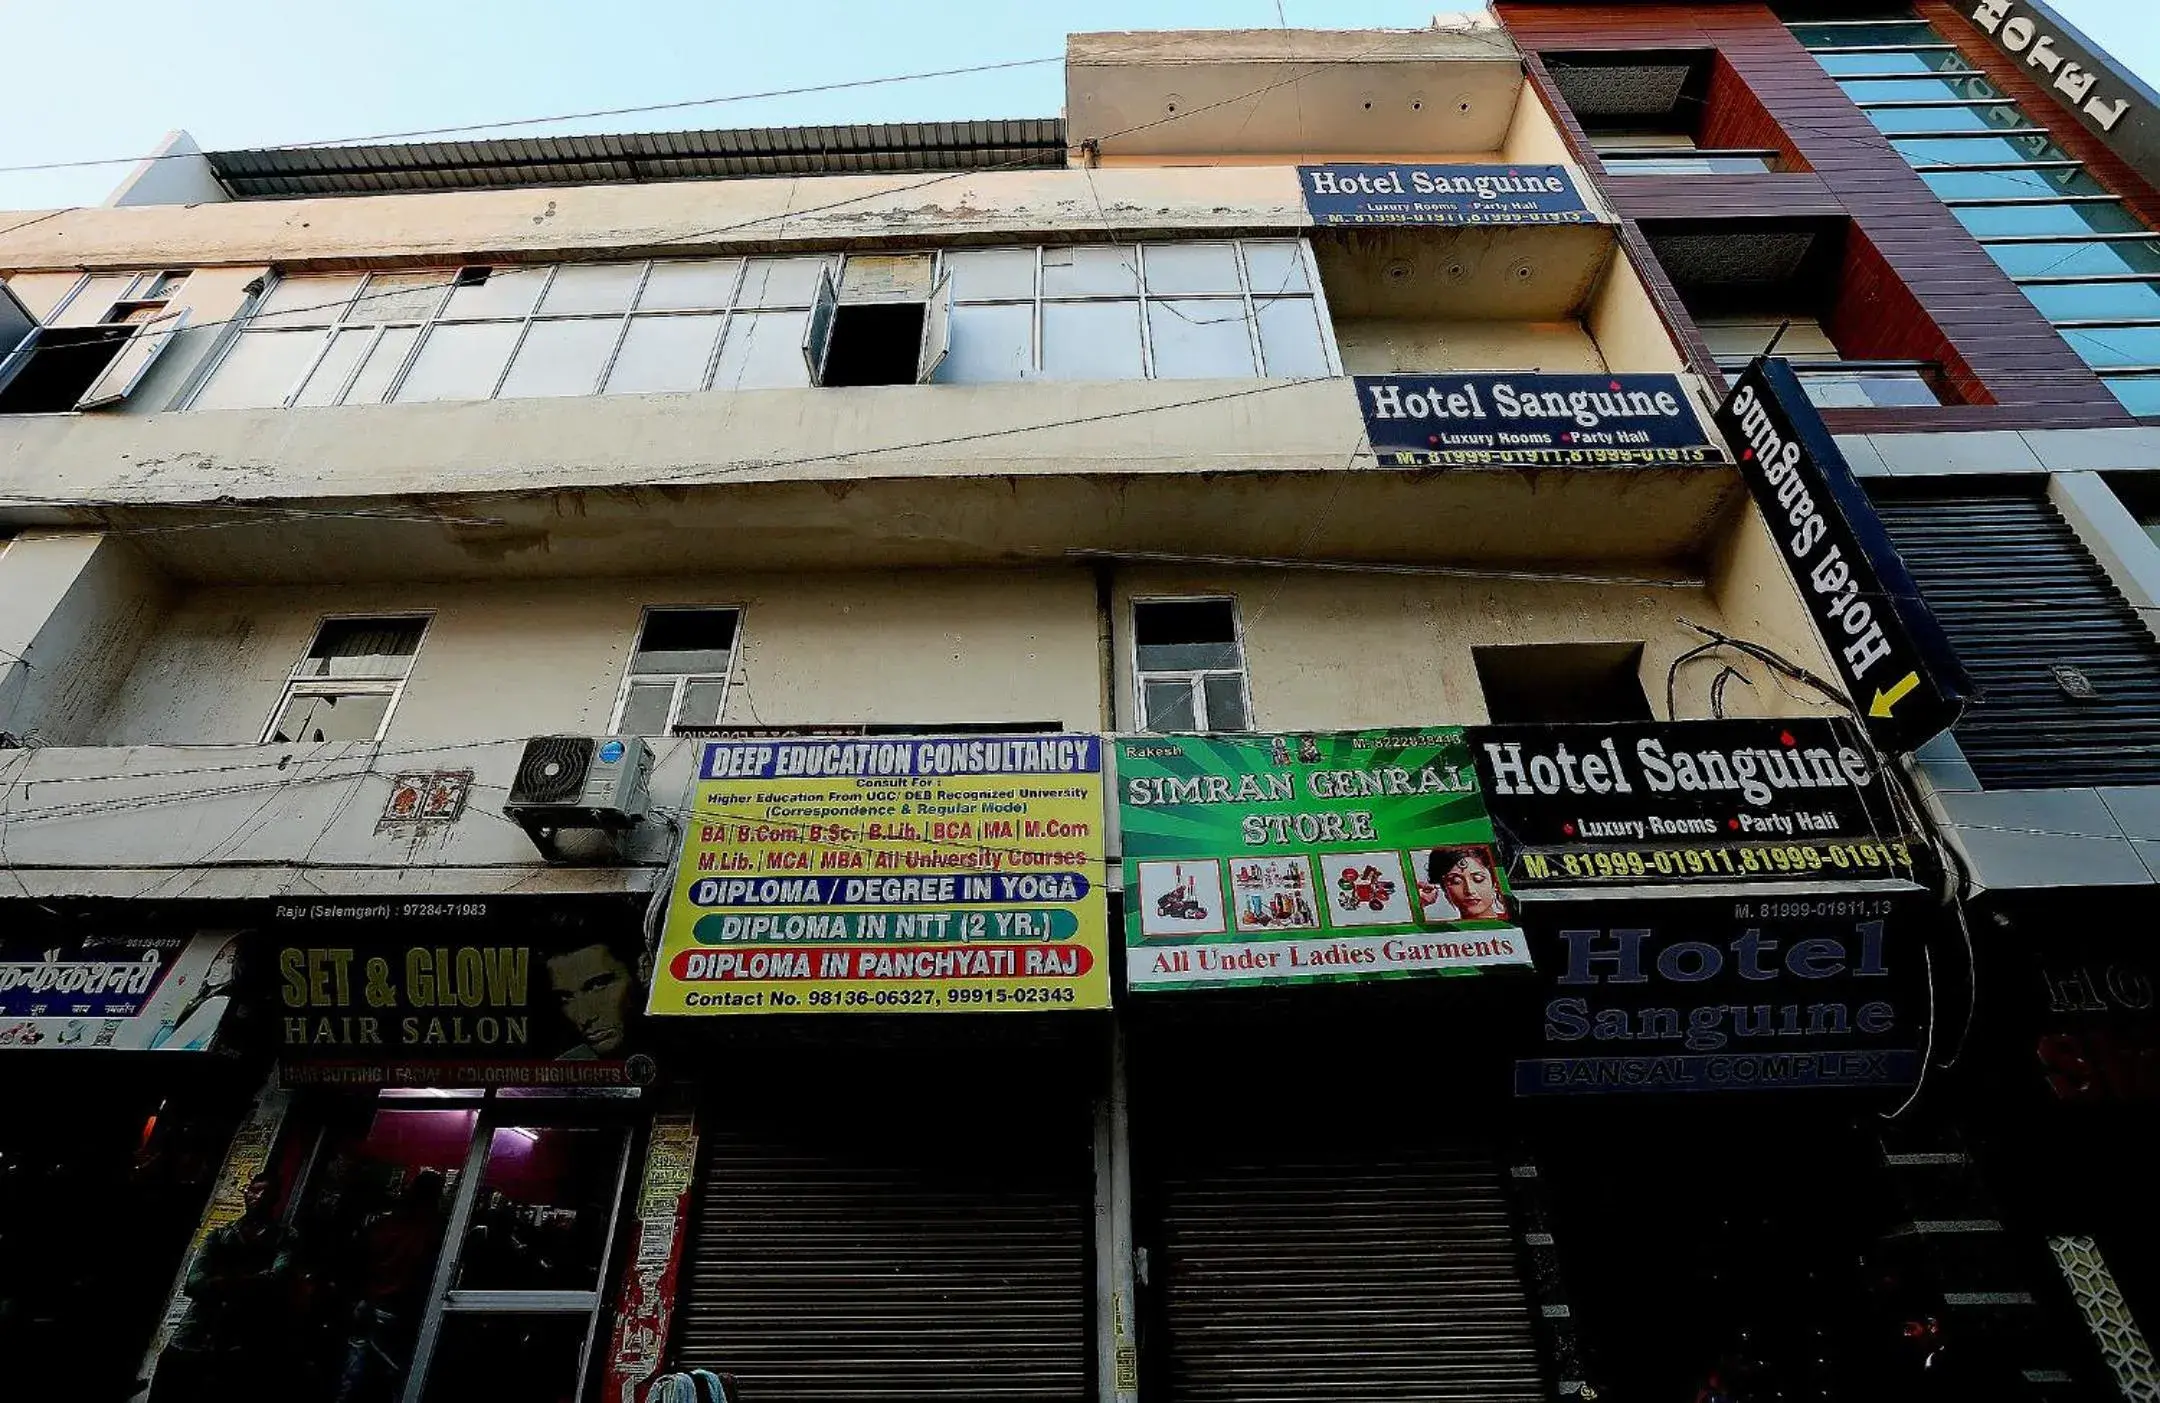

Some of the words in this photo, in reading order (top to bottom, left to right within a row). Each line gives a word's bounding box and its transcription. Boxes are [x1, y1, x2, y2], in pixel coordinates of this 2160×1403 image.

[1973, 0, 2131, 132] HOTEL
[1310, 171, 1405, 194] Hotel
[1411, 169, 1565, 200] Sanguine
[1367, 202, 1409, 212] Luxury
[1414, 202, 1458, 211] Rooms
[1472, 202, 1507, 212] Party
[1511, 202, 1539, 210] Hall
[1369, 383, 1487, 419] Hotel
[1492, 380, 1680, 428] Sanguine
[1440, 432, 1493, 447] Luxury
[1498, 431, 1552, 444] Rooms
[1570, 431, 1613, 445] Party
[1616, 429, 1650, 443] Hall
[1395, 451, 1422, 465] M.
[1733, 385, 1827, 558] Sanguine
[1811, 544, 1891, 680] Hotel
[711, 746, 773, 777] DEEP
[776, 744, 912, 776] EDUCATION
[917, 740, 1089, 774] CONSULTANCY
[1126, 746, 1183, 759] Rakesh
[856, 779, 907, 788] Consult
[911, 778, 932, 787] For
[1483, 737, 1632, 795] Hotel
[1636, 730, 1873, 806] Sanguine
[707, 793, 752, 806] Higher
[756, 793, 823, 803] Education
[828, 792, 862, 802] From
[904, 791, 931, 800] DEB
[937, 789, 1015, 802] Recognized
[1019, 788, 1088, 800] University
[1128, 773, 1295, 806] SIMRAN
[1308, 765, 1477, 798] GENRAL
[765, 804, 895, 818] (Correspondence
[900, 803, 911, 814] &
[917, 802, 977, 816] Regular
[981, 802, 1028, 814] Mode)
[1577, 818, 1645, 839] Luxury
[1648, 816, 1718, 835] Rooms
[1737, 812, 1793, 835] Party
[1795, 810, 1840, 831] Hall
[933, 820, 972, 839] BCA
[984, 820, 1013, 838] MA
[1242, 810, 1378, 847] STORE
[766, 851, 809, 869] MCA
[820, 850, 863, 869] MBA
[875, 851, 899, 869] All
[905, 850, 1003, 872] University
[1007, 850, 1088, 867] Courses
[1522, 852, 1558, 878] M.
[698, 878, 820, 904] DIPLOMA
[846, 876, 955, 904] DEGREE
[964, 876, 992, 900] IN
[1000, 874, 1077, 900] YOGA
[276, 905, 306, 920] Raju
[403, 903, 487, 917] 97284-71983
[1735, 903, 1754, 919] M.
[721, 914, 847, 940] DIPLOMA
[856, 914, 886, 939] IN
[895, 913, 951, 939] NTT
[960, 912, 986, 942] (2
[994, 911, 1051, 942] YR.)
[686, 952, 811, 979] DIPLOMA
[820, 952, 850, 977] IN
[858, 950, 1015, 977] PANCHYATI
[1025, 949, 1078, 975] RAJ
[1152, 950, 1191, 974] All
[1196, 947, 1280, 971] Under
[1288, 943, 1377, 967] Ladies
[1382, 936, 1514, 963] Garments
[1557, 919, 1889, 985] Hotel
[279, 948, 354, 1007] SET
[365, 956, 398, 1008] &
[405, 947, 530, 1007] GLOW
[685, 991, 764, 1006] Contact
[770, 991, 801, 1006] No.
[808, 990, 941, 1007] 98136-06327,
[946, 988, 1075, 1004] 99915-02343
[283, 1015, 383, 1045] HAIR
[402, 1015, 529, 1045] SALON
[1544, 998, 1895, 1051] Sanguine
[1542, 1057, 1695, 1086] BANSAL
[1706, 1052, 1888, 1084] COMPLEX
